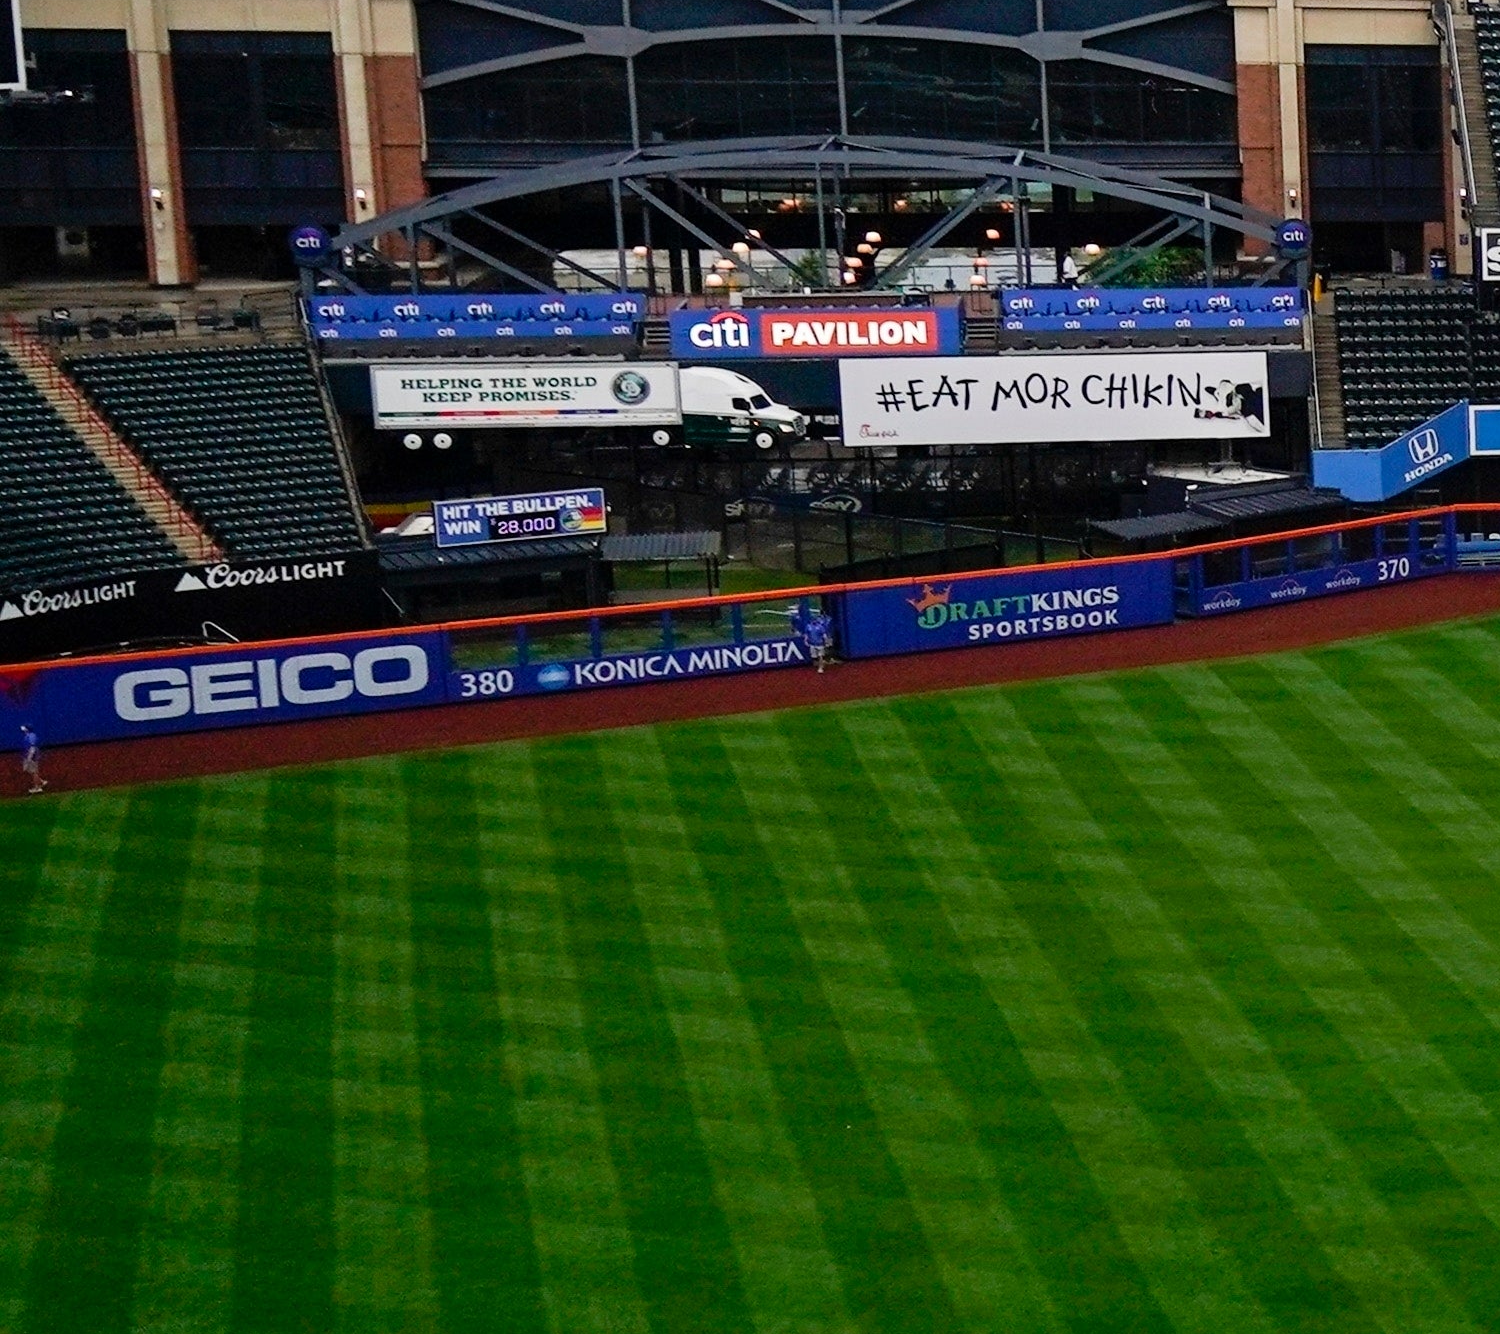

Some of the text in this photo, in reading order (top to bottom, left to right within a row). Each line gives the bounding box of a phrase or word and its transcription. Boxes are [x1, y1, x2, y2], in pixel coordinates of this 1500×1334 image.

[296, 234, 321, 248] citi
[1283, 228, 1304, 241] citi
[689, 312, 928, 348] citi PAVILION
[400, 375, 597, 390] HELPING THE WORLD
[423, 389, 576, 403] KEEP PROMISES.
[876, 372, 1202, 413] #EAT MOR CHIKIN
[1403, 452, 1453, 482] HONDA
[442, 494, 593, 521] HIT THE BULLPEN.
[444, 519, 481, 536] WIN
[205, 560, 346, 590] Coors LIGHT
[1377, 557, 1410, 581] 370
[22, 580, 136, 617] Coors LIGHT
[968, 609, 1119, 641] SPORTSBOOK
[575, 640, 803, 685] KONICA MINOLTA
[113, 644, 429, 722] GEICO
[460, 670, 514, 697] 380
